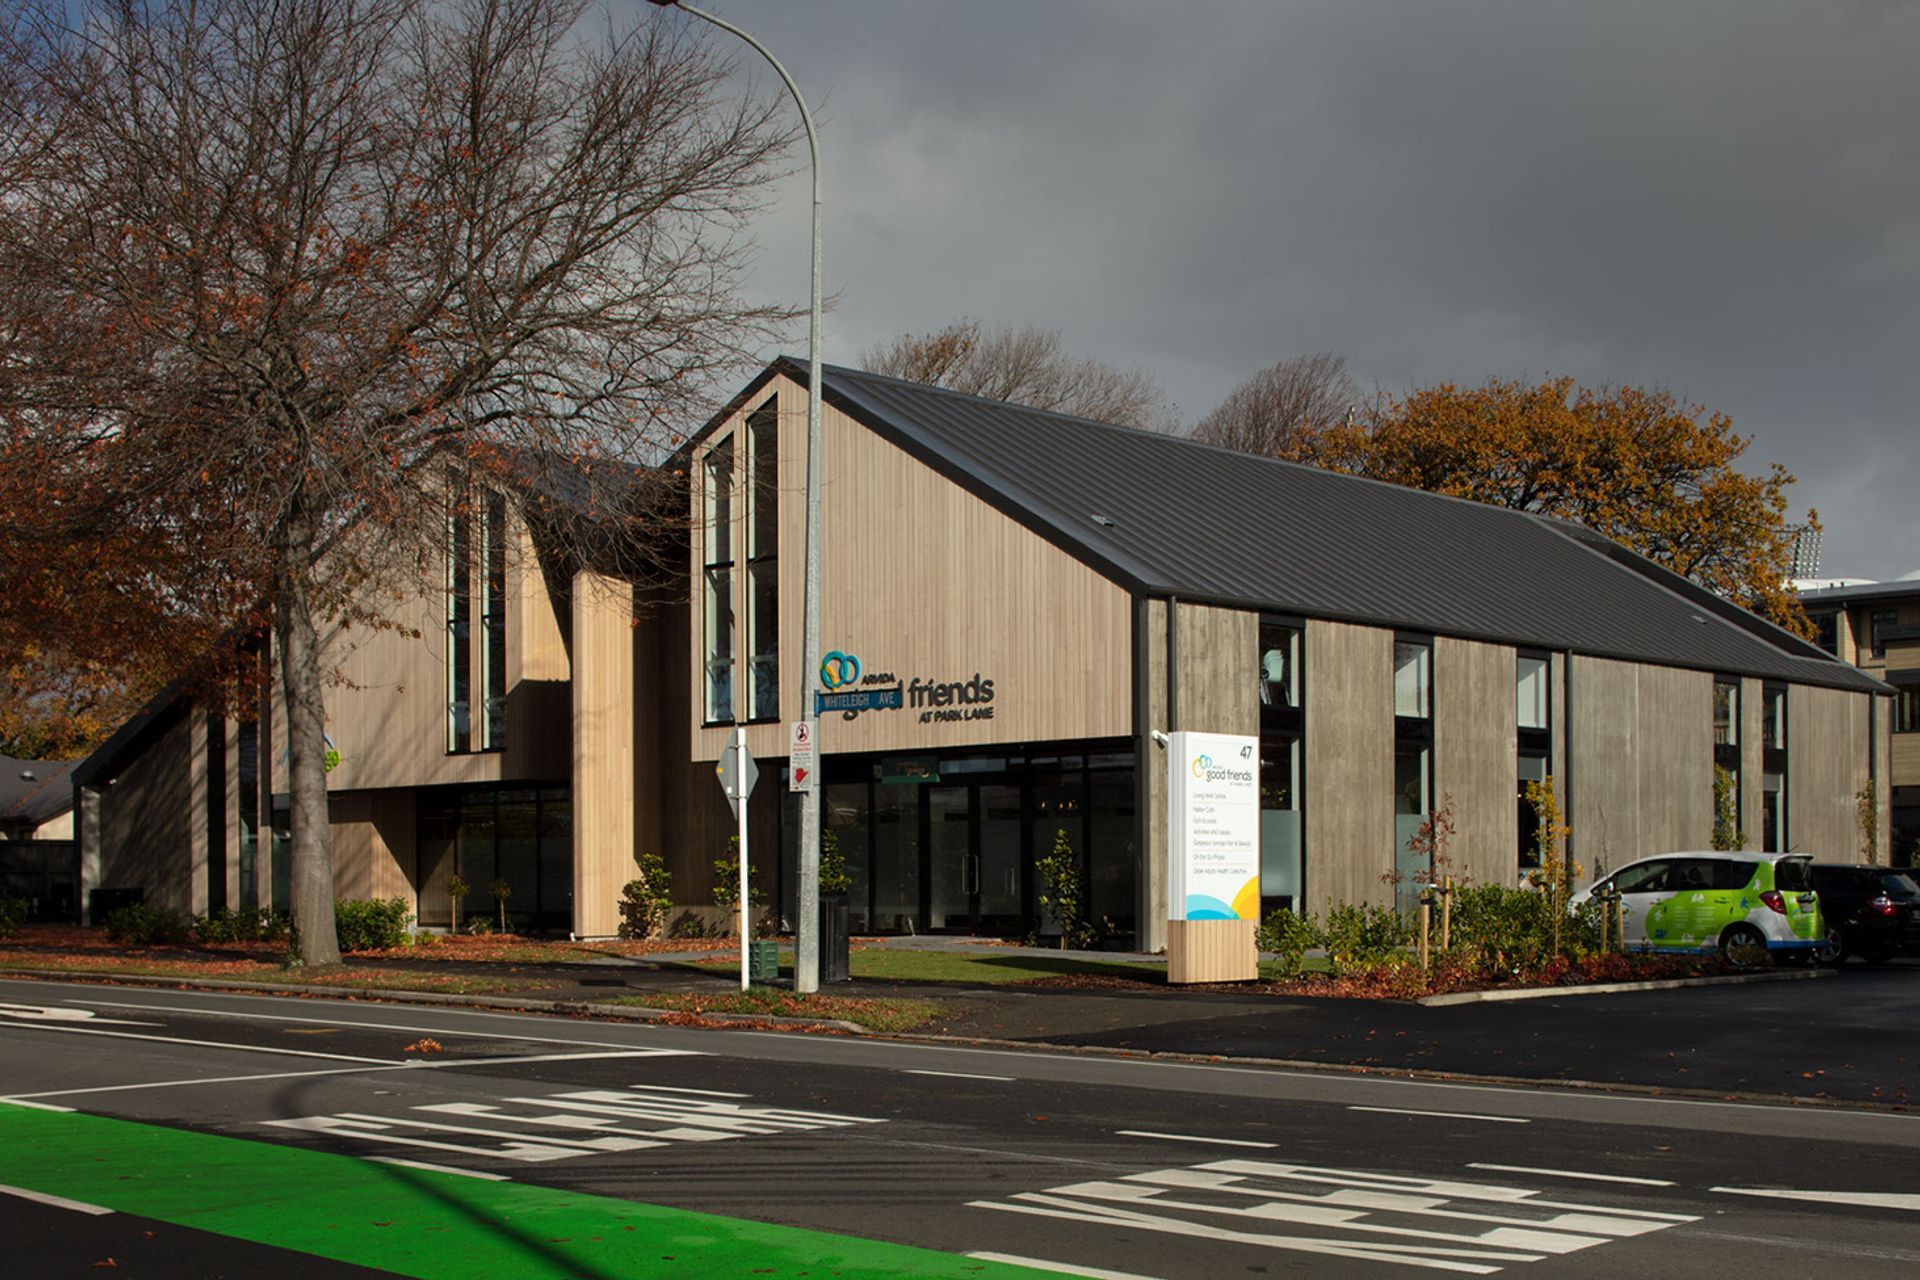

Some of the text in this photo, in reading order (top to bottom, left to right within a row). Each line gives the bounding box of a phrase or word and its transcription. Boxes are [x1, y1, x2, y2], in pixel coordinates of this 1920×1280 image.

[861, 672, 896, 686] ARVIDA
[908, 672, 995, 708] friends
[824, 691, 895, 709] WHITELEIGH AVE
[919, 706, 995, 724] AT PARK LANE
[1240, 745, 1253, 759] 47
[1206, 768, 1253, 783] good friends
[258, 1090, 889, 1161] CLEAR
[963, 1160, 1704, 1274] KEEP
